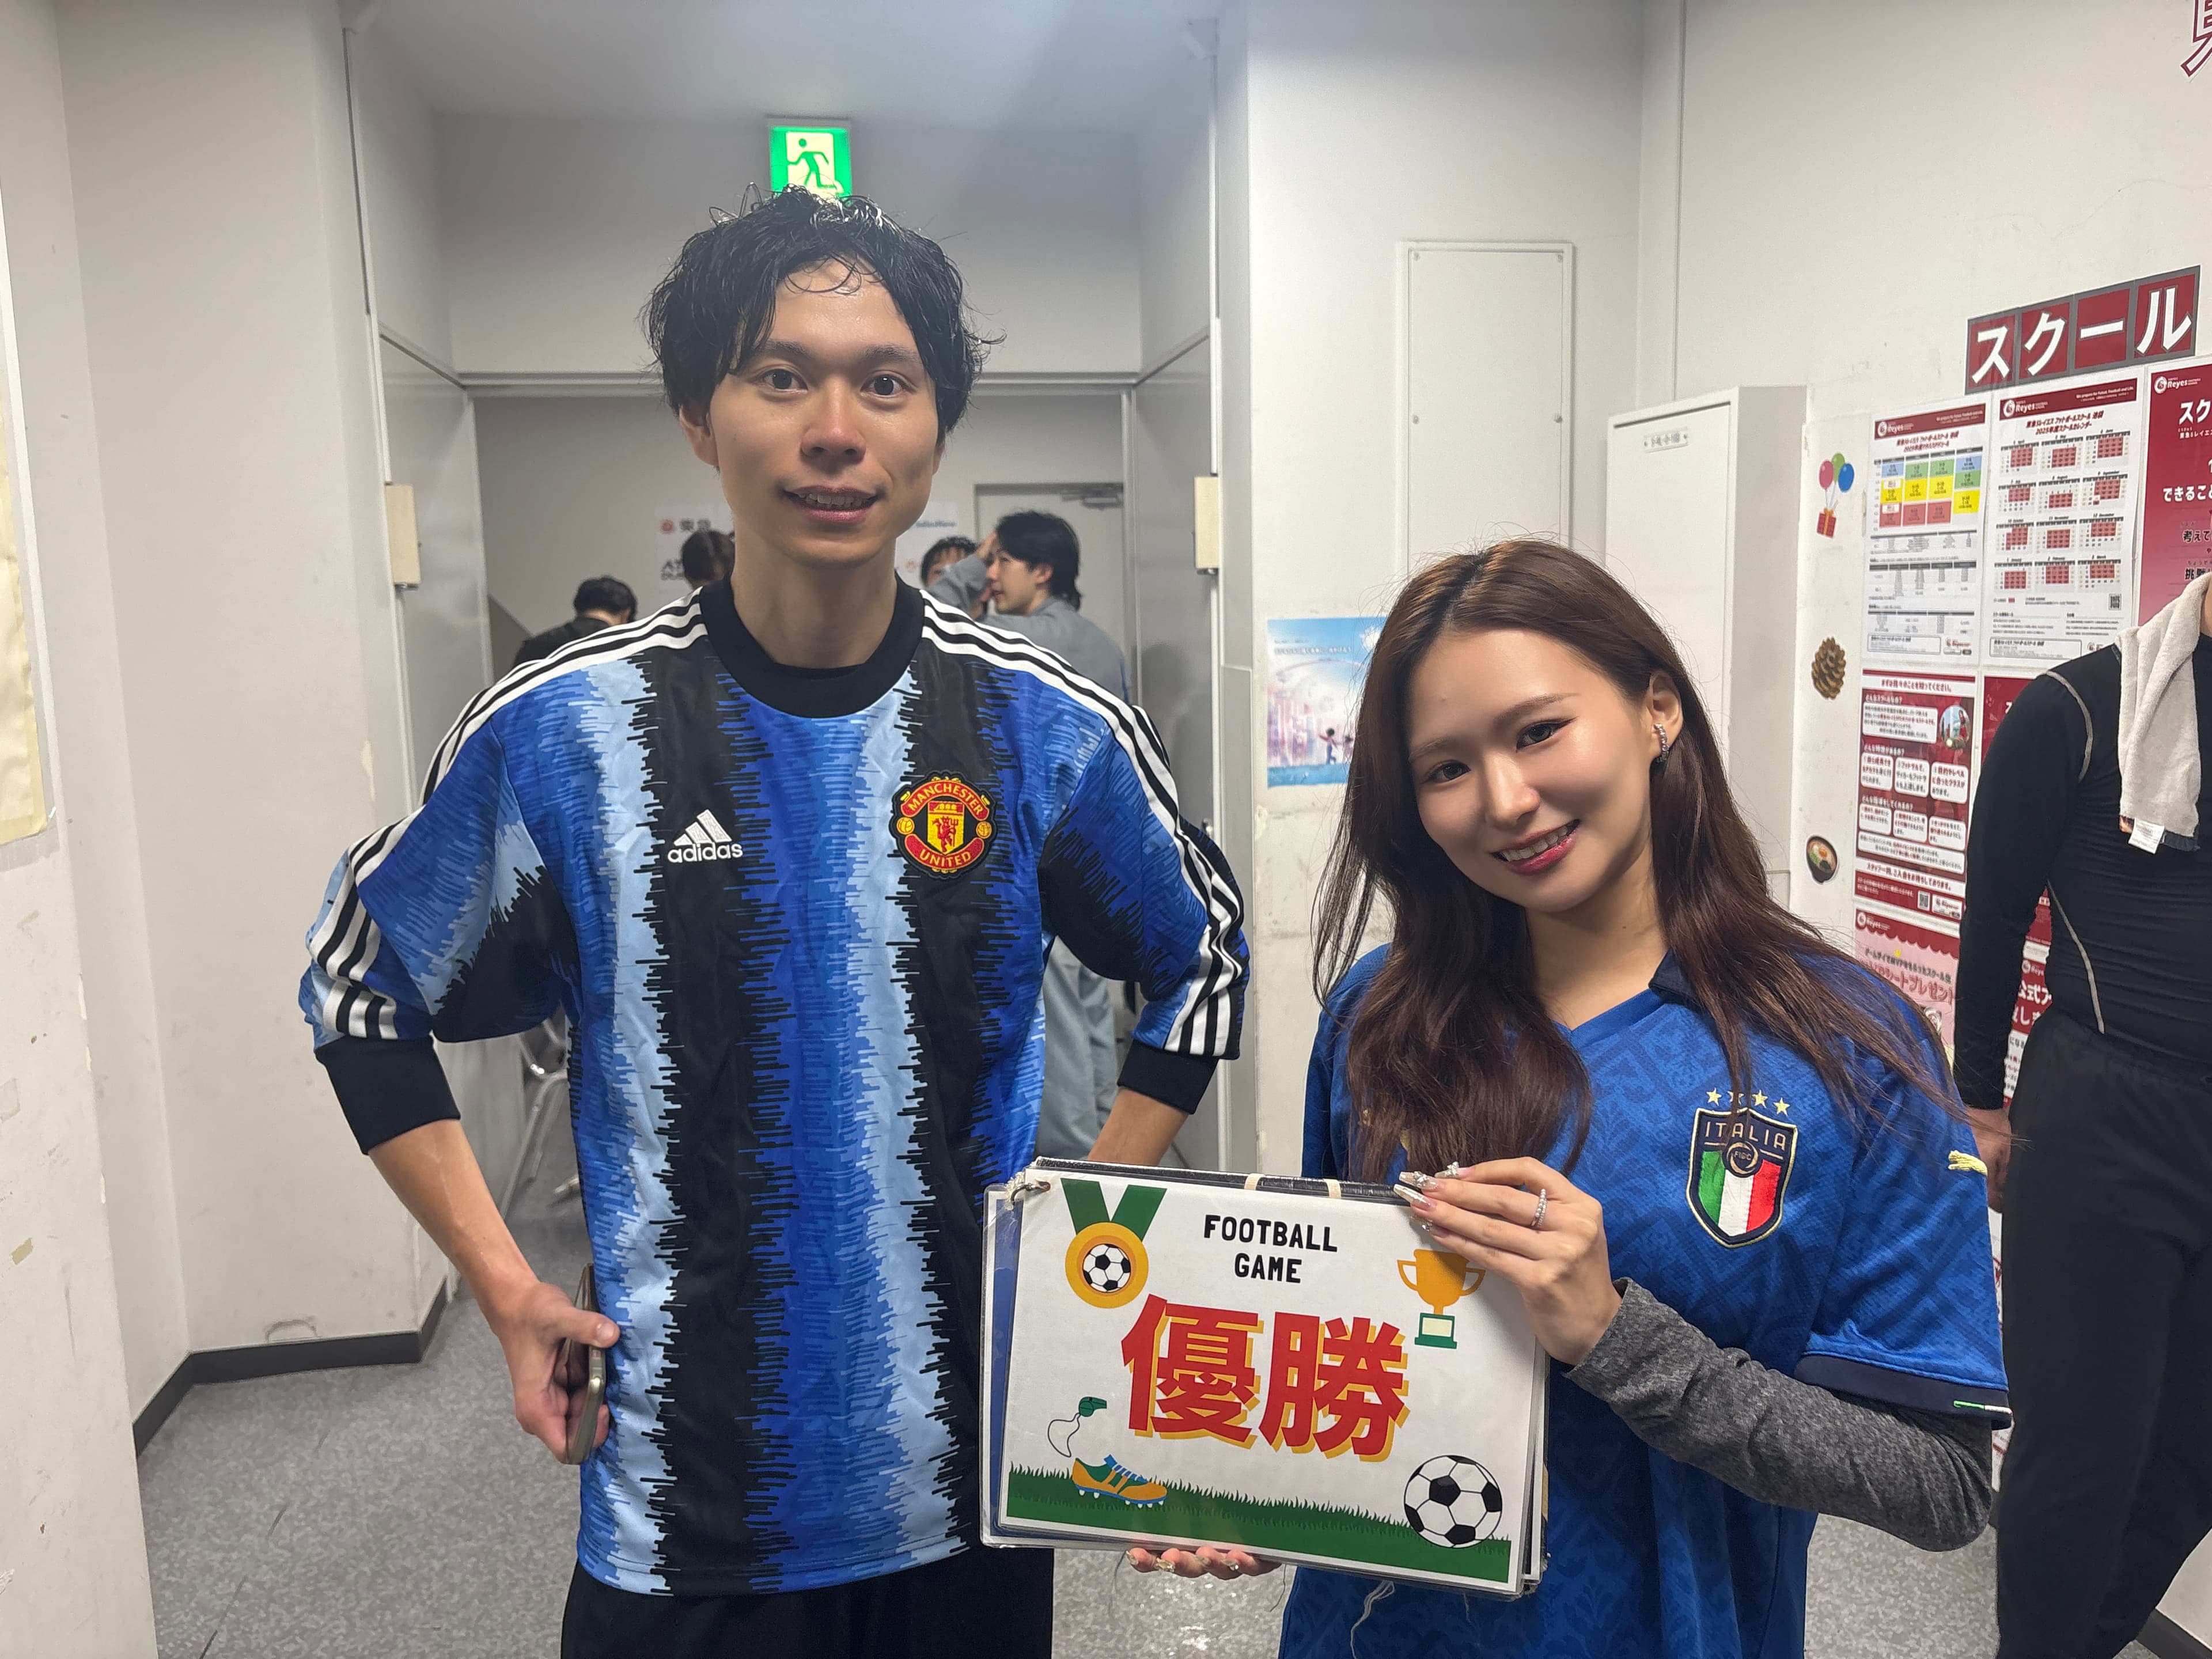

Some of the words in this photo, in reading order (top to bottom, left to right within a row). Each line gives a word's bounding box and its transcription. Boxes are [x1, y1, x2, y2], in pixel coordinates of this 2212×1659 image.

[1971, 286, 2192, 384] スクール
[2167, 379, 2188, 389] Reyes
[2179, 399, 2211, 425] スク
[2183, 530, 2211, 543] 考えて
[908, 783, 984, 815] MANCHESTER
[668, 842, 743, 863] adidas
[919, 849, 971, 867] UNITED
[1704, 1121, 1787, 1151] ITALIA
[1203, 1214, 1339, 1252] FOOTBALL
[1233, 1253, 1302, 1284] GAME
[1120, 1293, 1411, 1463] 優勝
